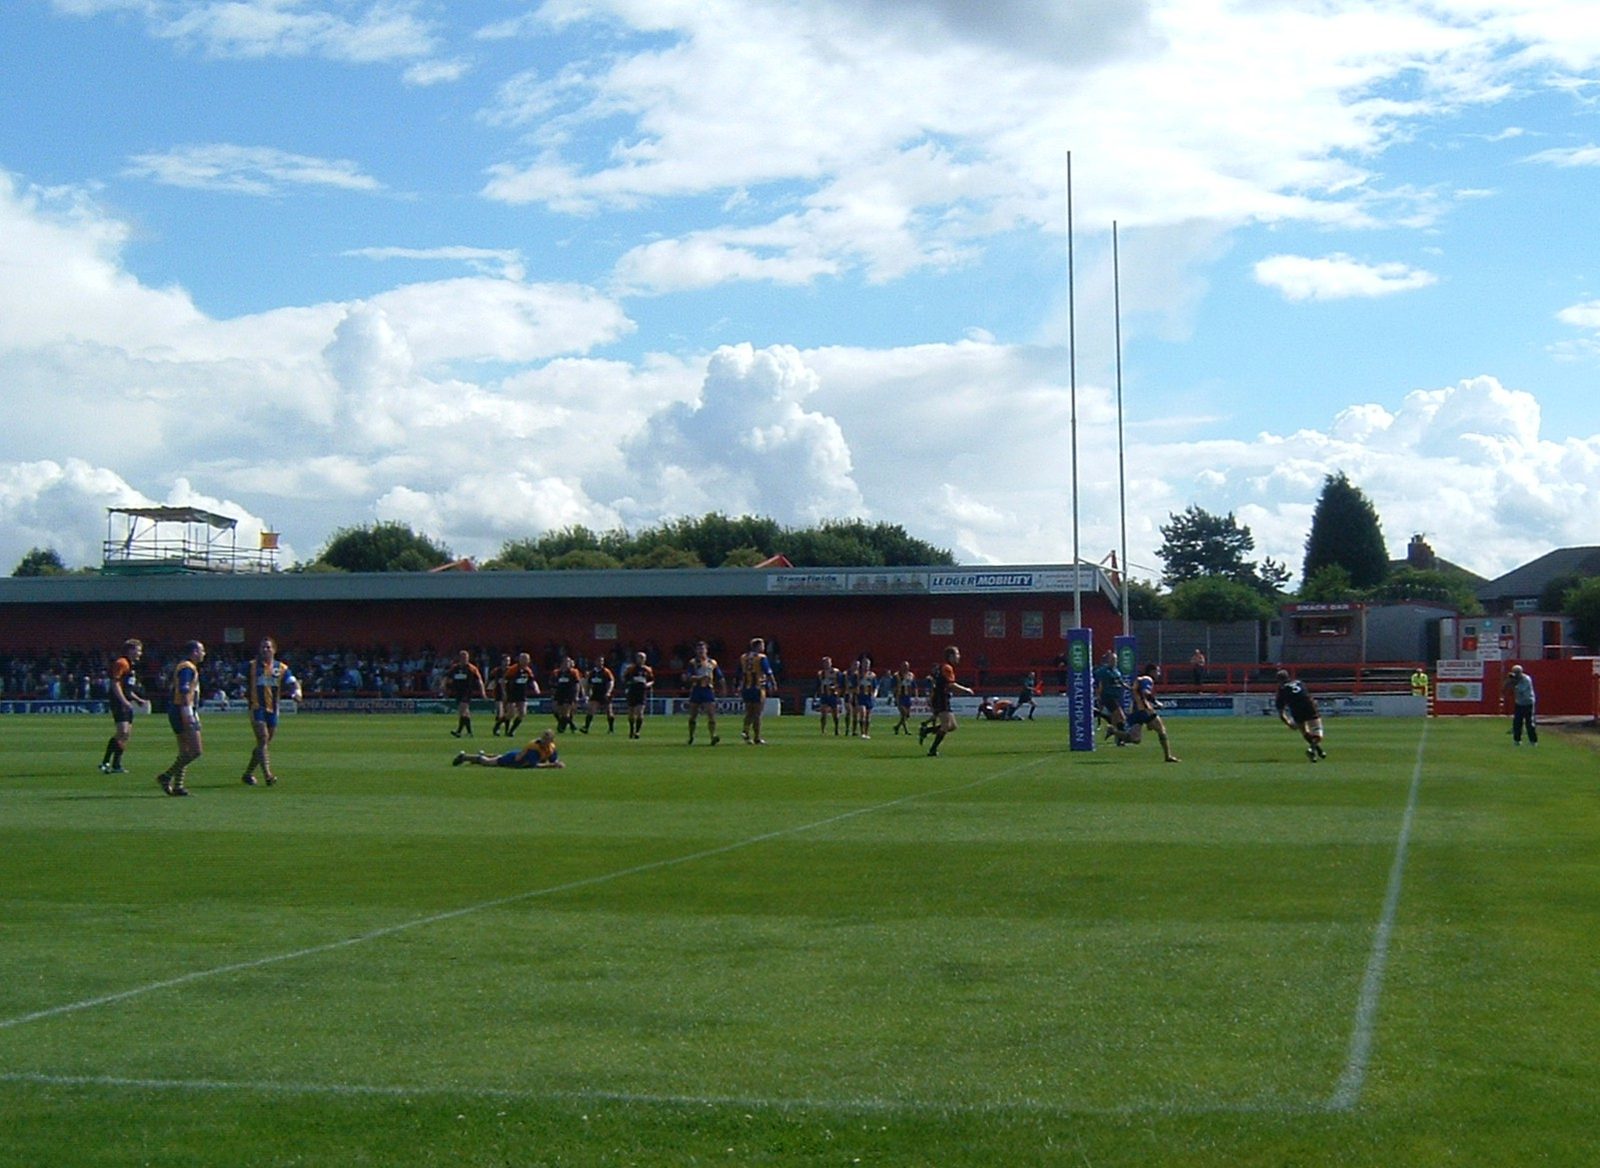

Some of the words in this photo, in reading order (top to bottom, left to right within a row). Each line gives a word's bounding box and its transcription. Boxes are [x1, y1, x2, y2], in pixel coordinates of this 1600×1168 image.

[932, 574, 976, 587] LEDGER
[976, 573, 1032, 586] MOBILITY
[25, 702, 90, 714] Loans
[1073, 672, 1085, 742] HEALTHPLAN
